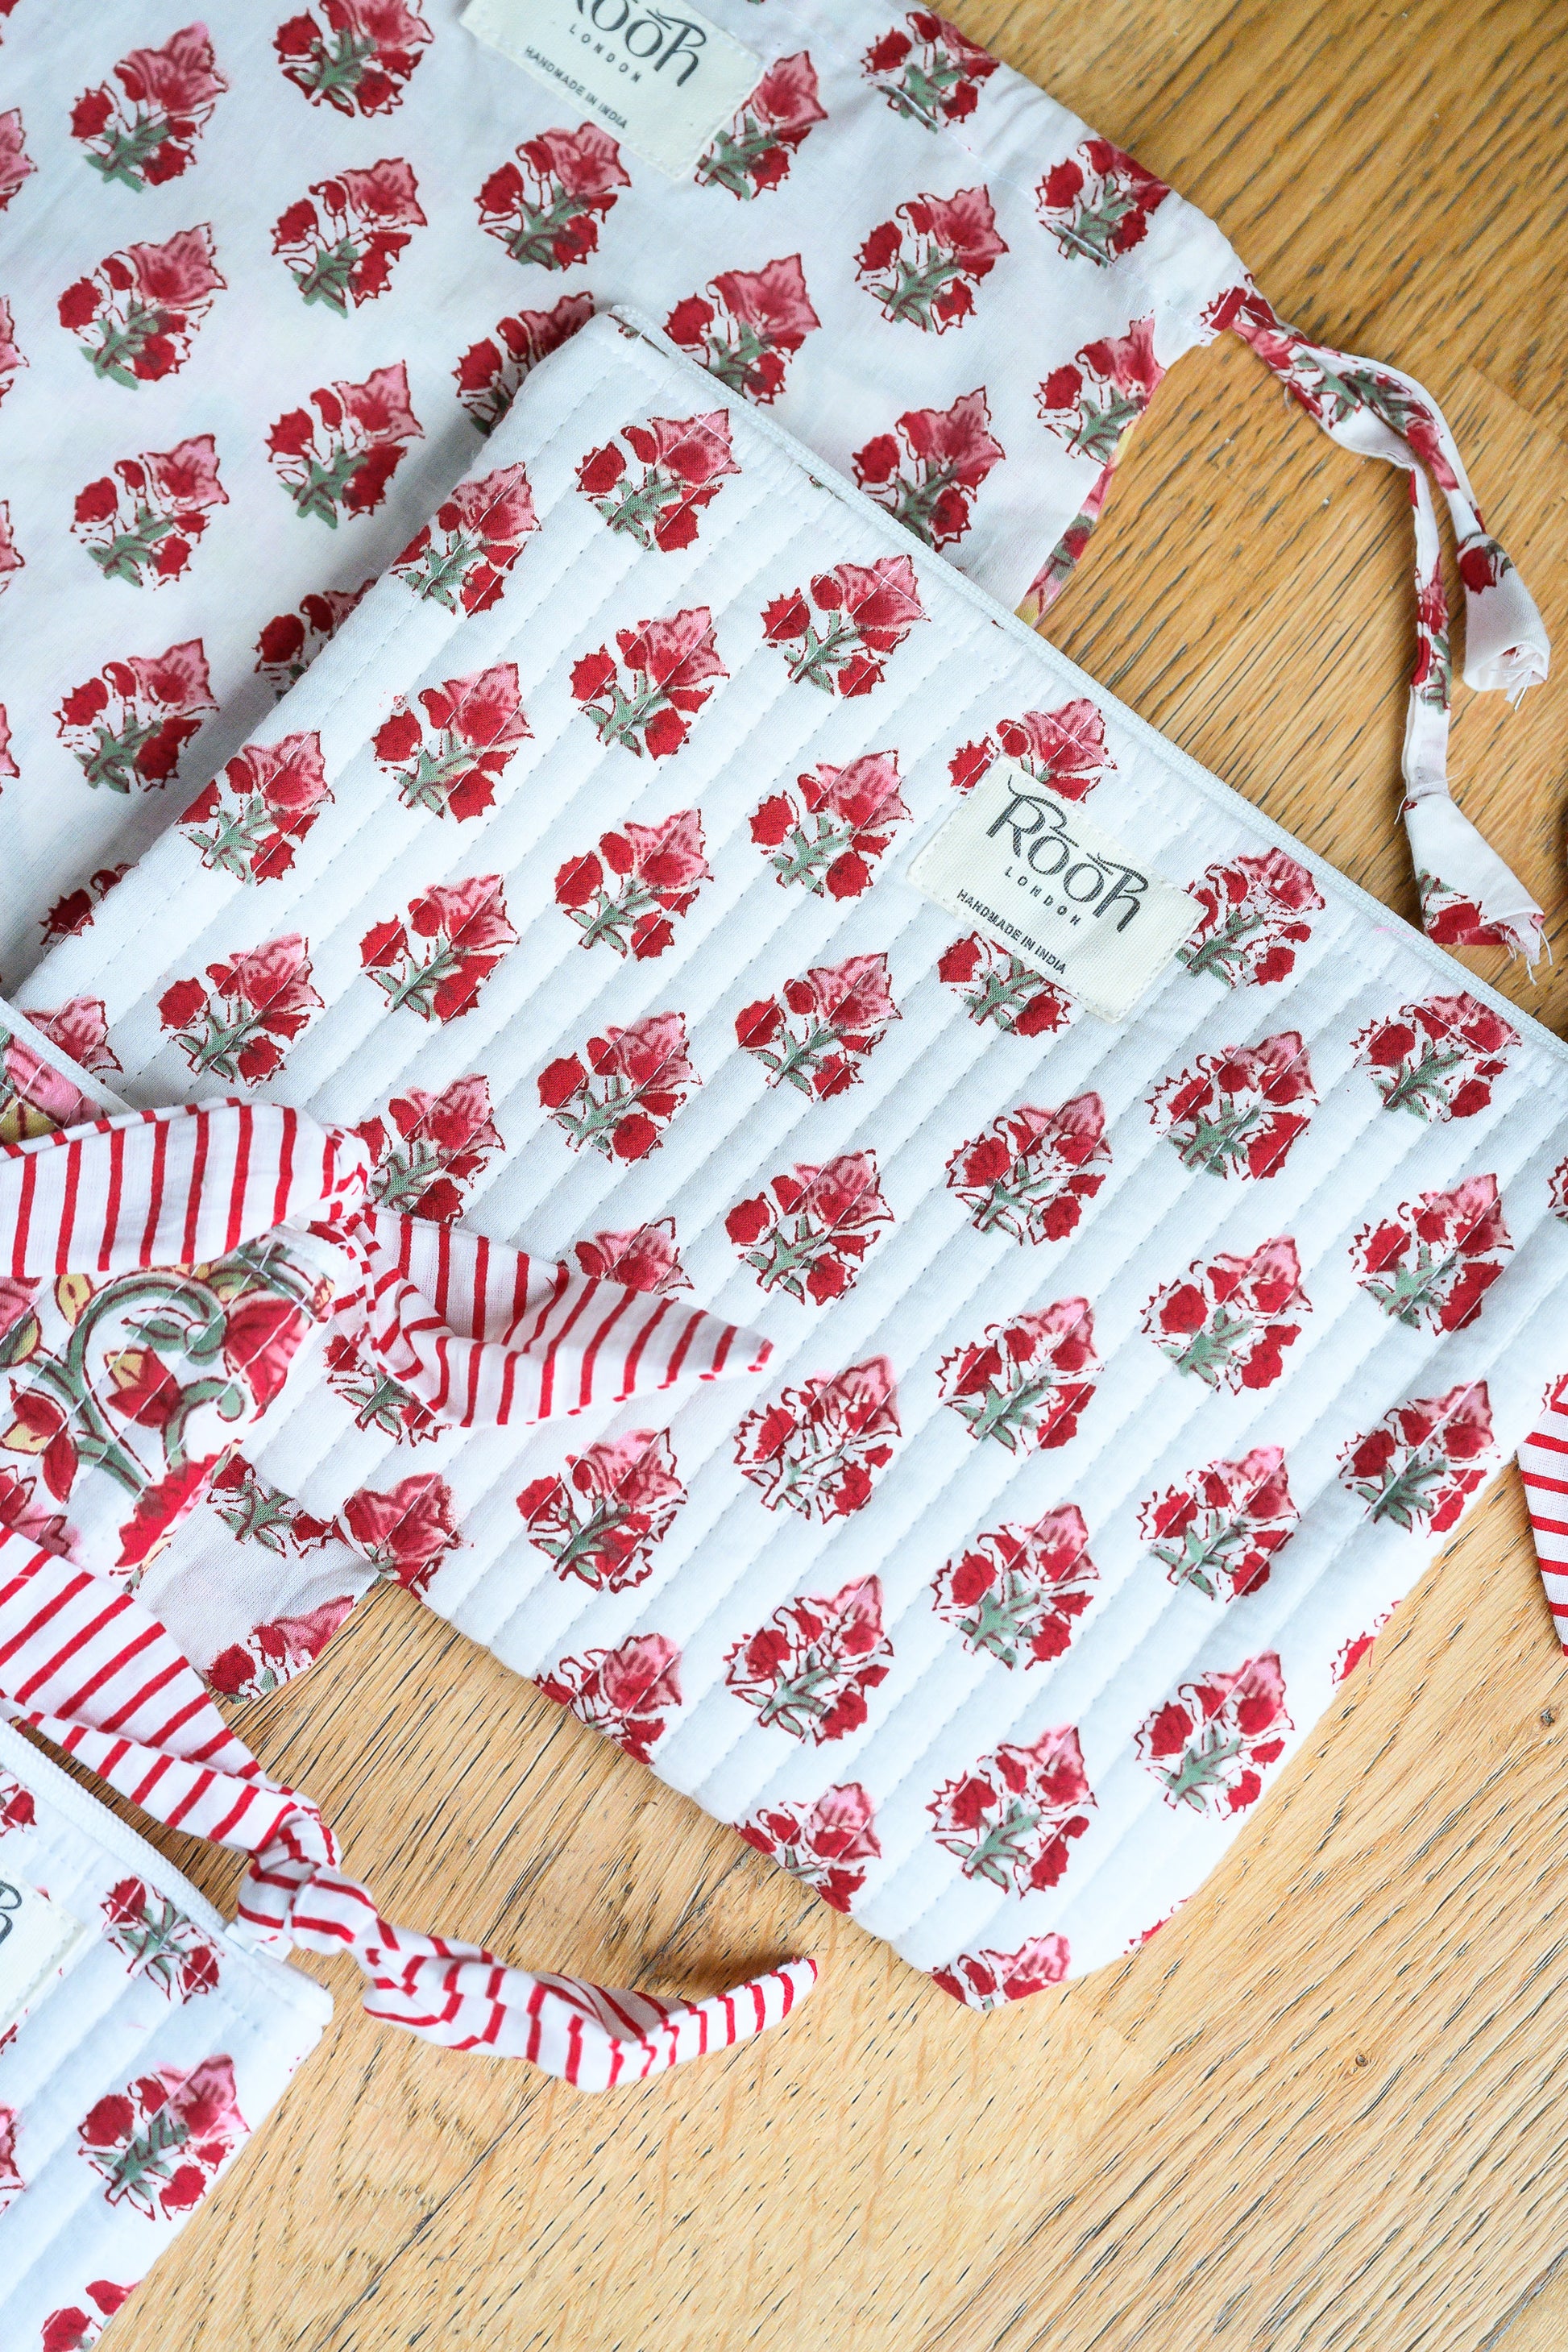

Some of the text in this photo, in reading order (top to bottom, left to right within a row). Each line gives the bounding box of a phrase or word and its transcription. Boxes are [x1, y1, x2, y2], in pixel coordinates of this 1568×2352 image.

[525, 46, 628, 129] HANDMADE IN INDIA
[569, 24, 641, 83] LONDON
[956, 889, 1066, 975] HANDMADE IN INDIA
[1004, 865, 1081, 927] LONDON
